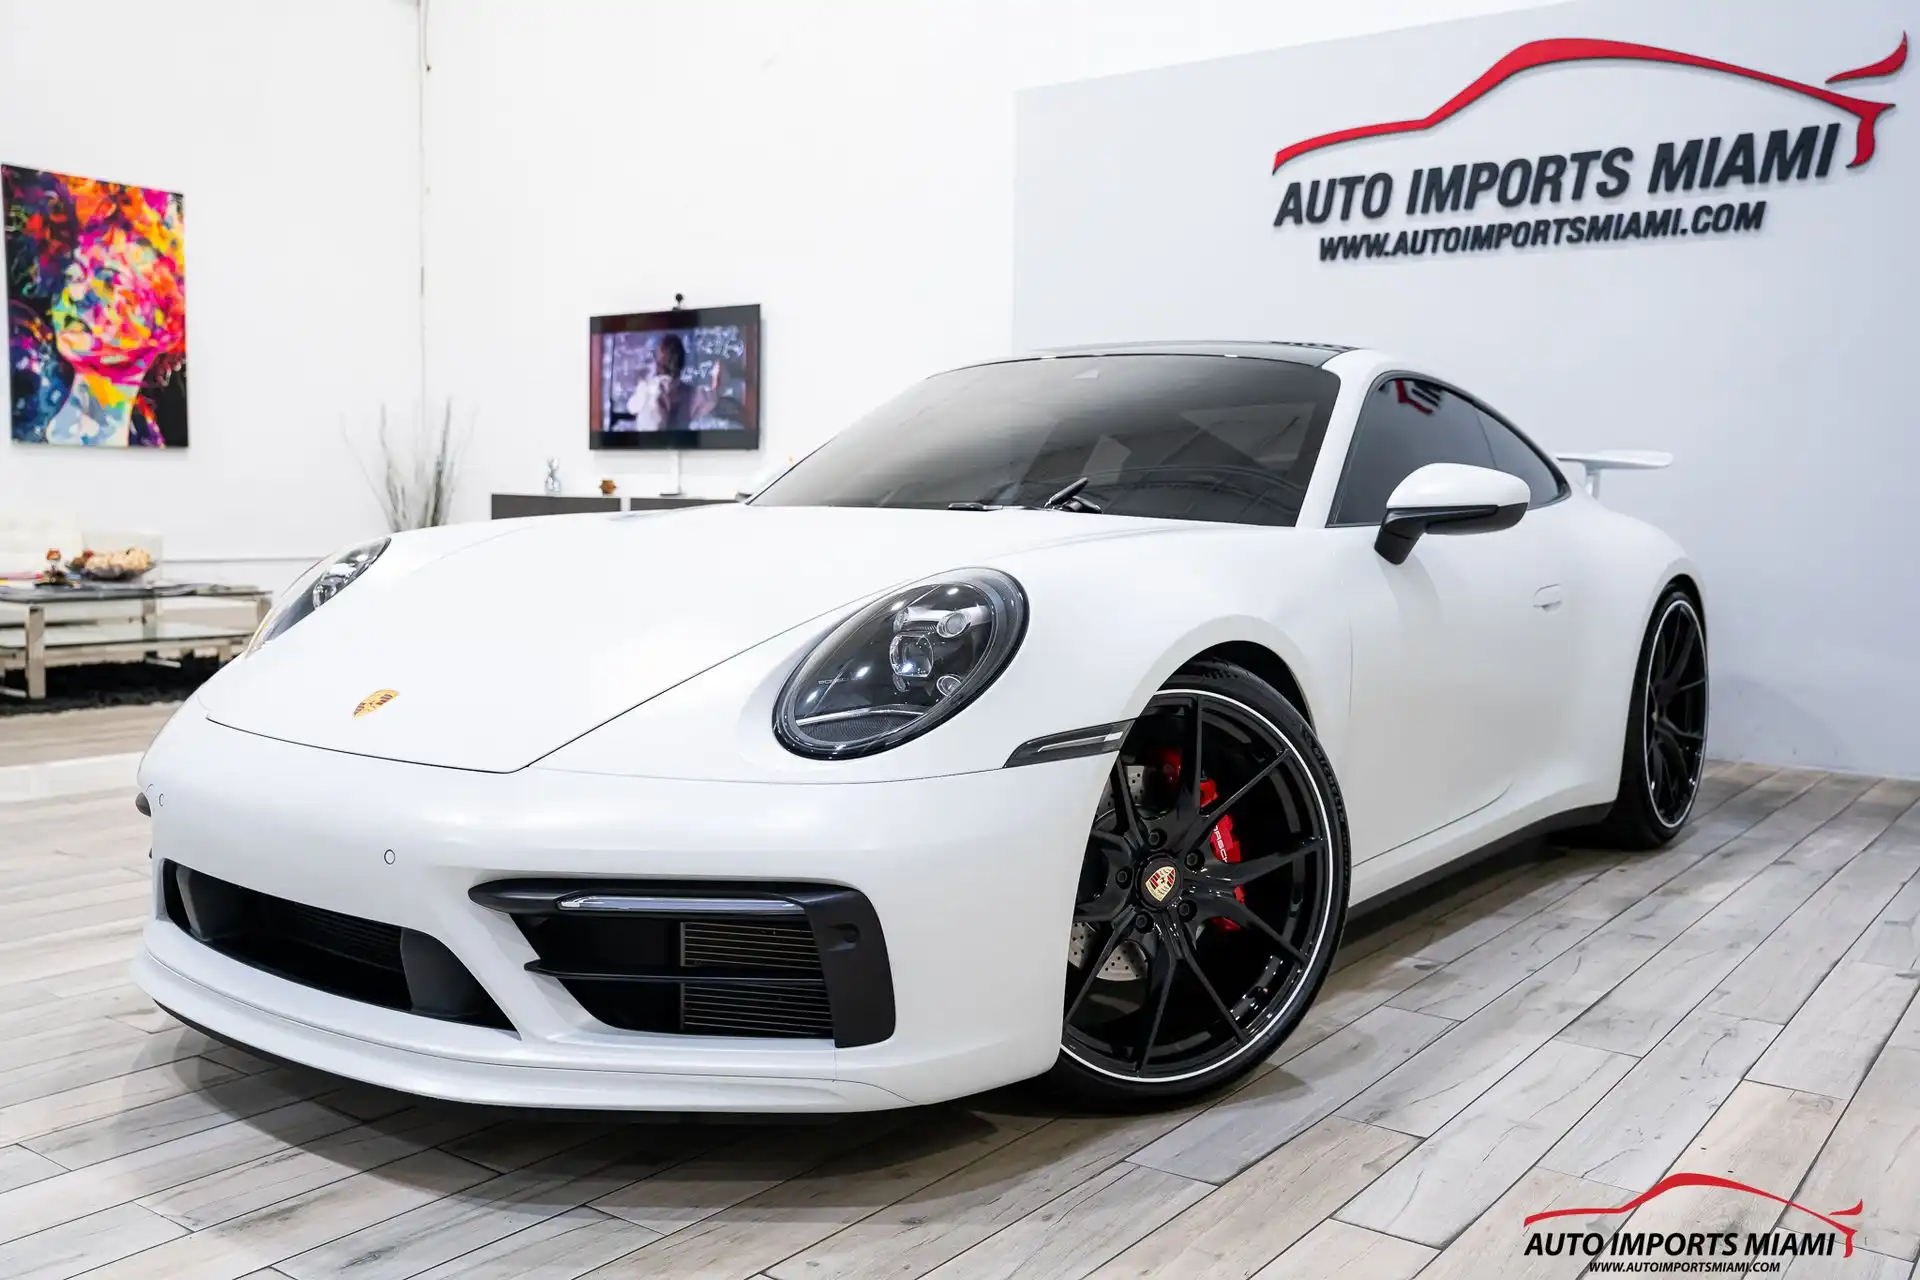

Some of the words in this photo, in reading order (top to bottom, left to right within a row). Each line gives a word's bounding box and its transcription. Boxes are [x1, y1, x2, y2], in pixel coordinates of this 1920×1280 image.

[1273, 172, 1394, 227] AUTO
[1406, 147, 1634, 215] IMPORTS
[1647, 123, 1841, 194] MIAMI
[1319, 201, 1768, 262] WWW.AUTOIMPORTSMIAMI.COM
